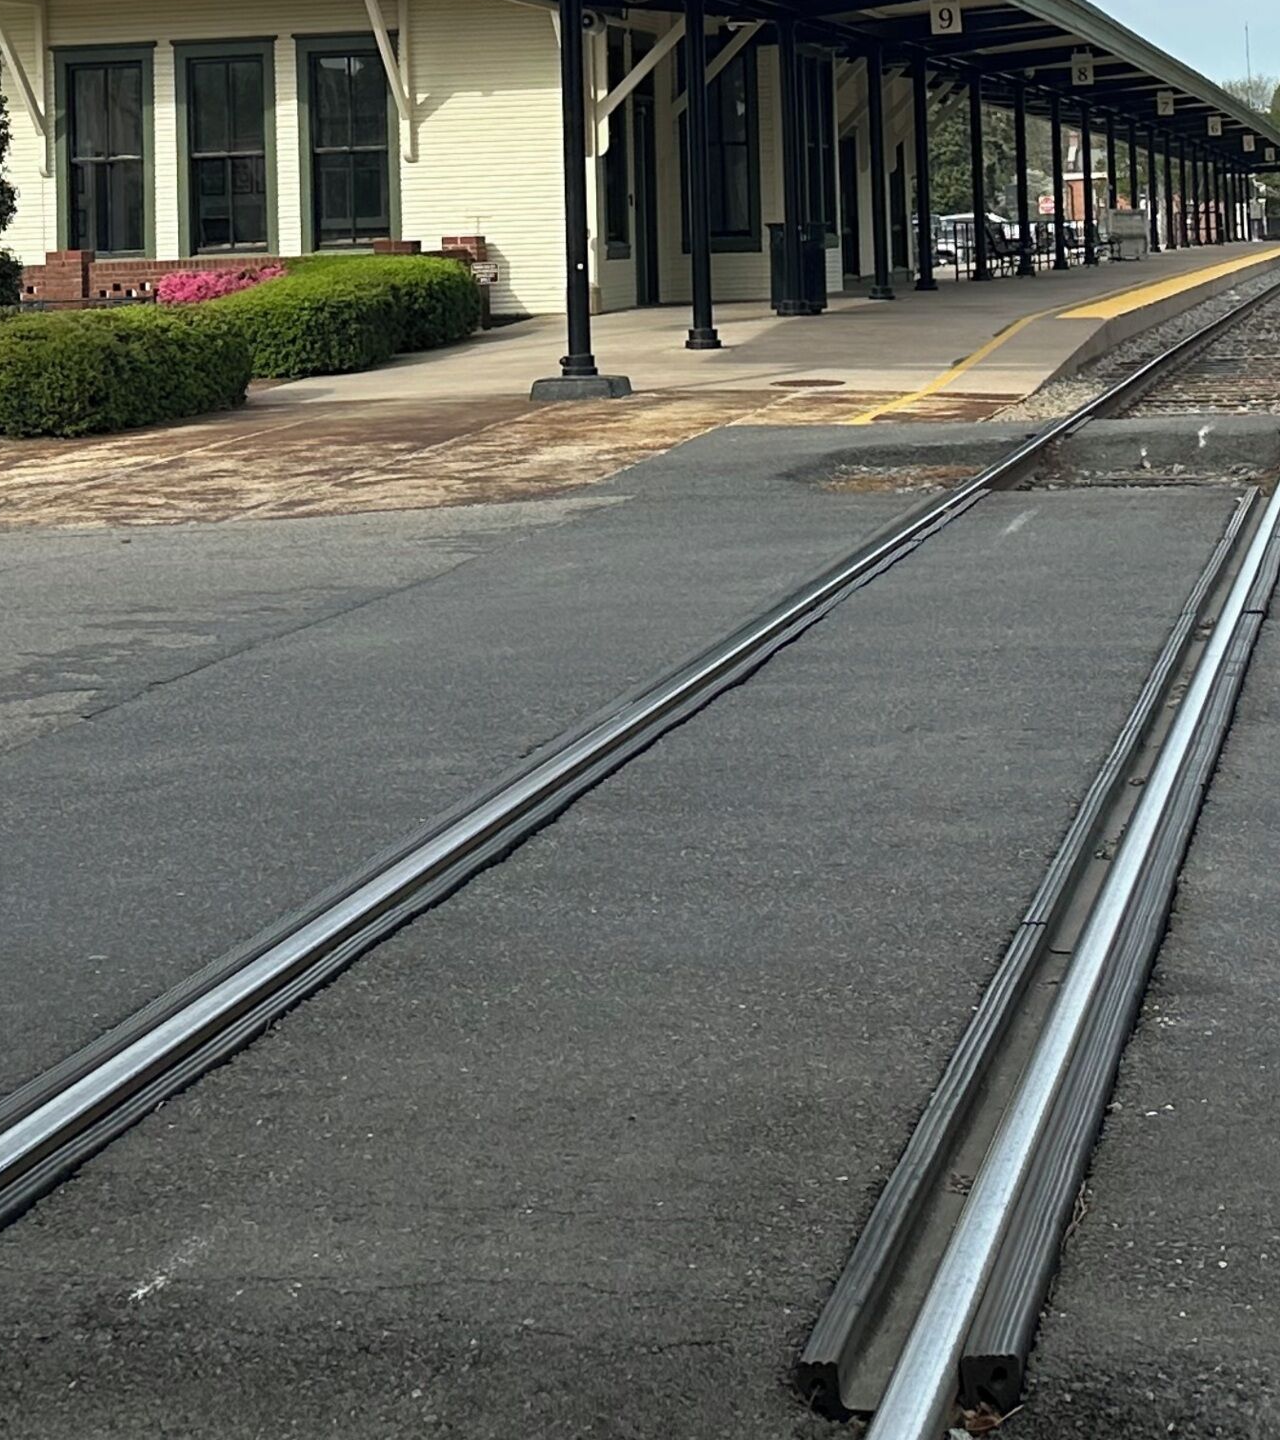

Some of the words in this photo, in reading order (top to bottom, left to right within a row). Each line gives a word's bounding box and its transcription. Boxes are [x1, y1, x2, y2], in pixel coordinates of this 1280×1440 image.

[938, 7, 954, 30] 9
[1077, 66, 1088, 82] 8
[1161, 101, 1170, 112] 7
